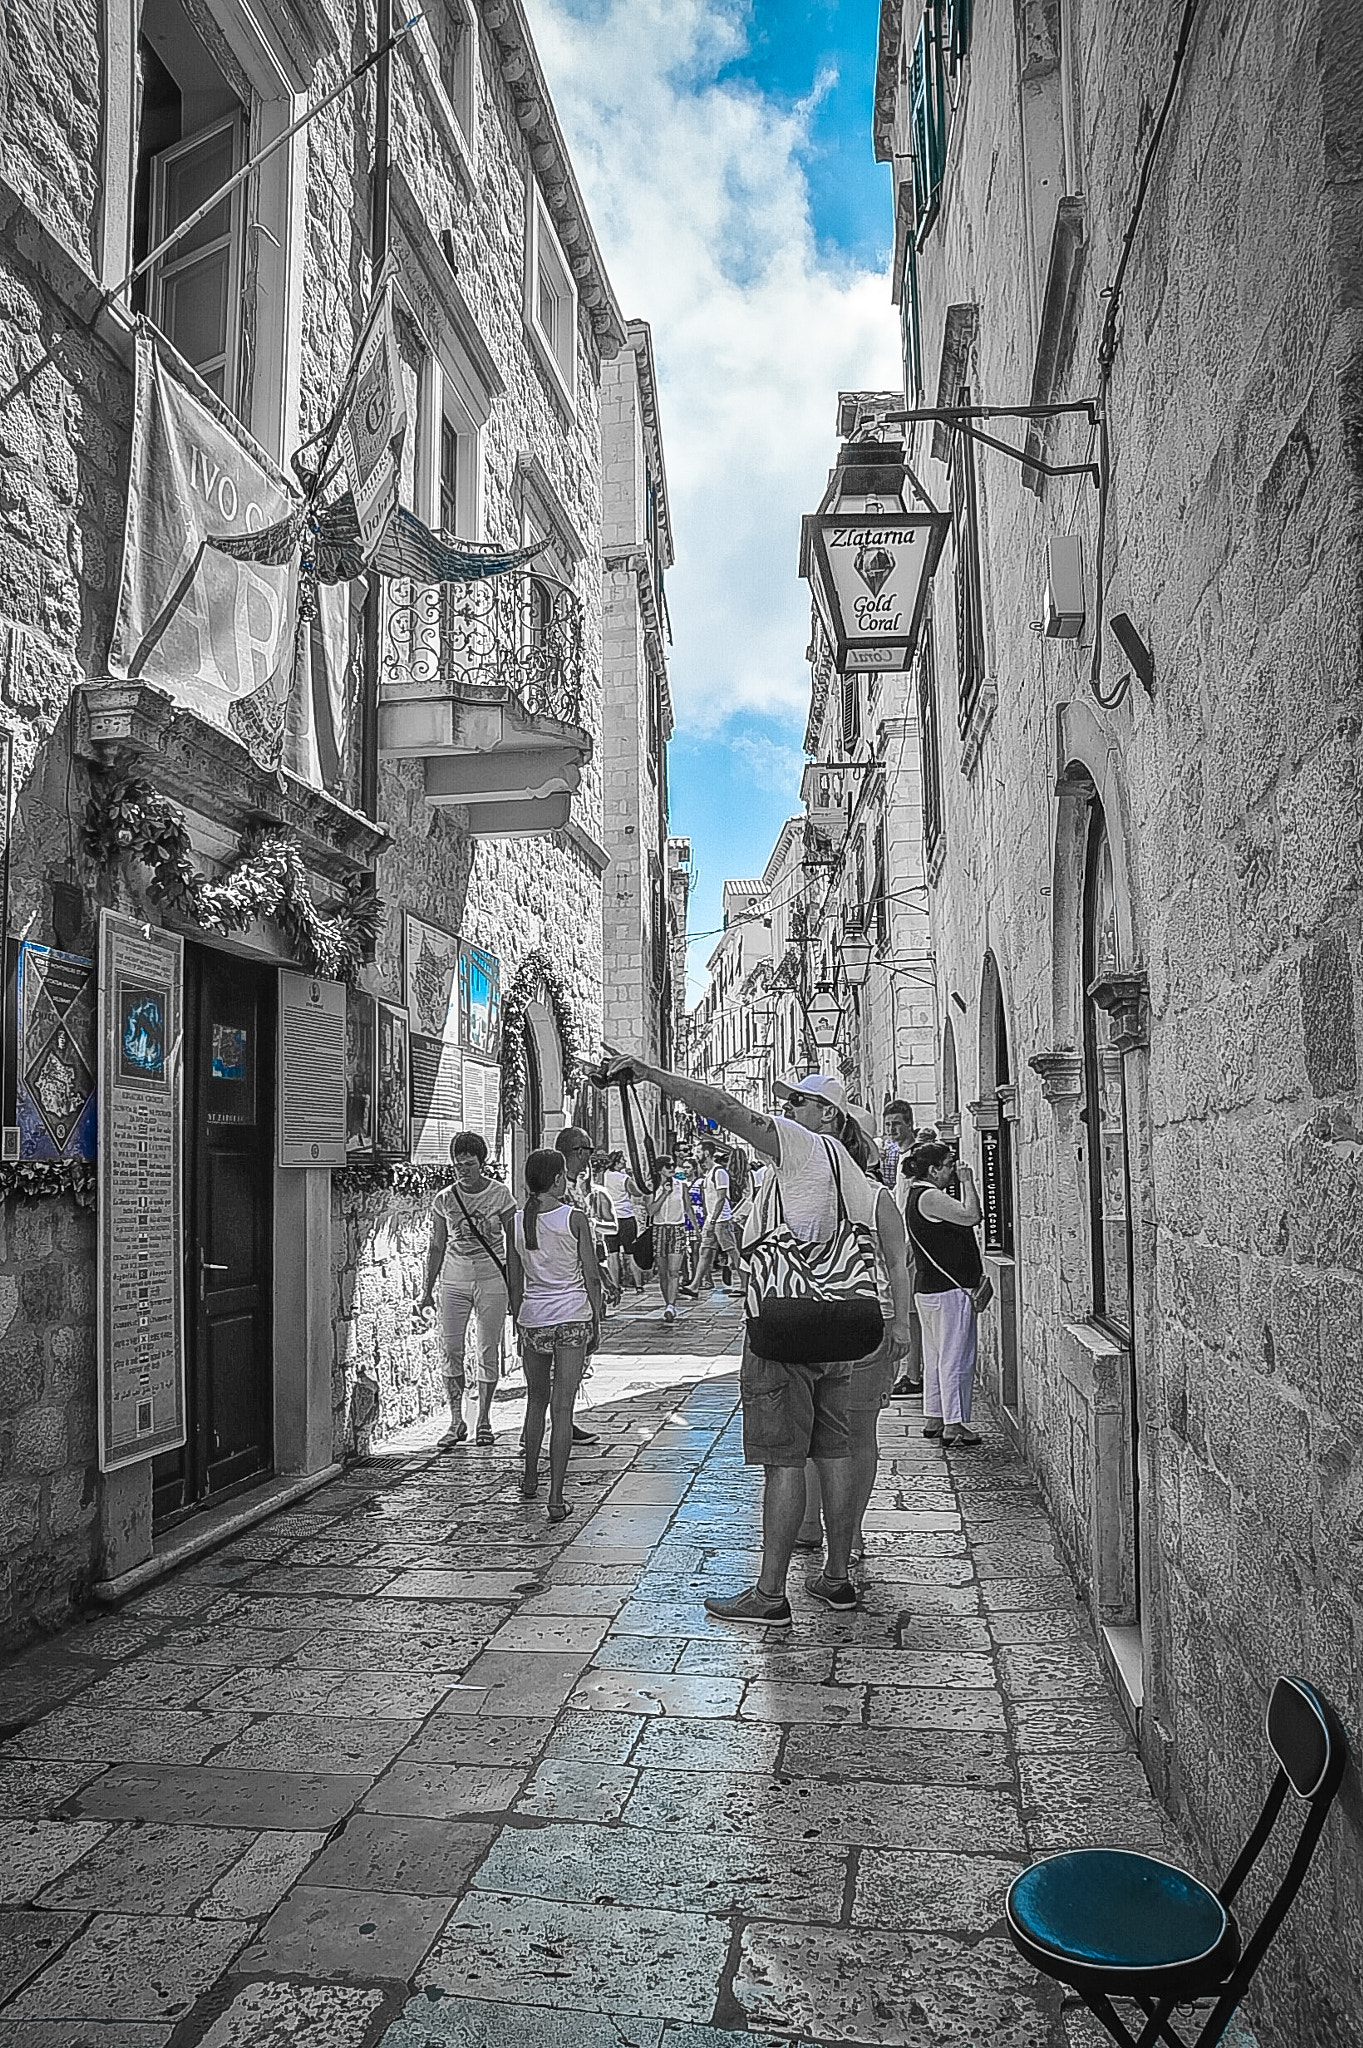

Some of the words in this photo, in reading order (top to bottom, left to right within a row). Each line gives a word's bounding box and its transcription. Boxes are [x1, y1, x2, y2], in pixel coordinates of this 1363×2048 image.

[190, 444, 238, 522] IVO
[829, 528, 916, 548] Zlatarna
[853, 593, 898, 618] Gold
[858, 613, 903, 632] Coral
